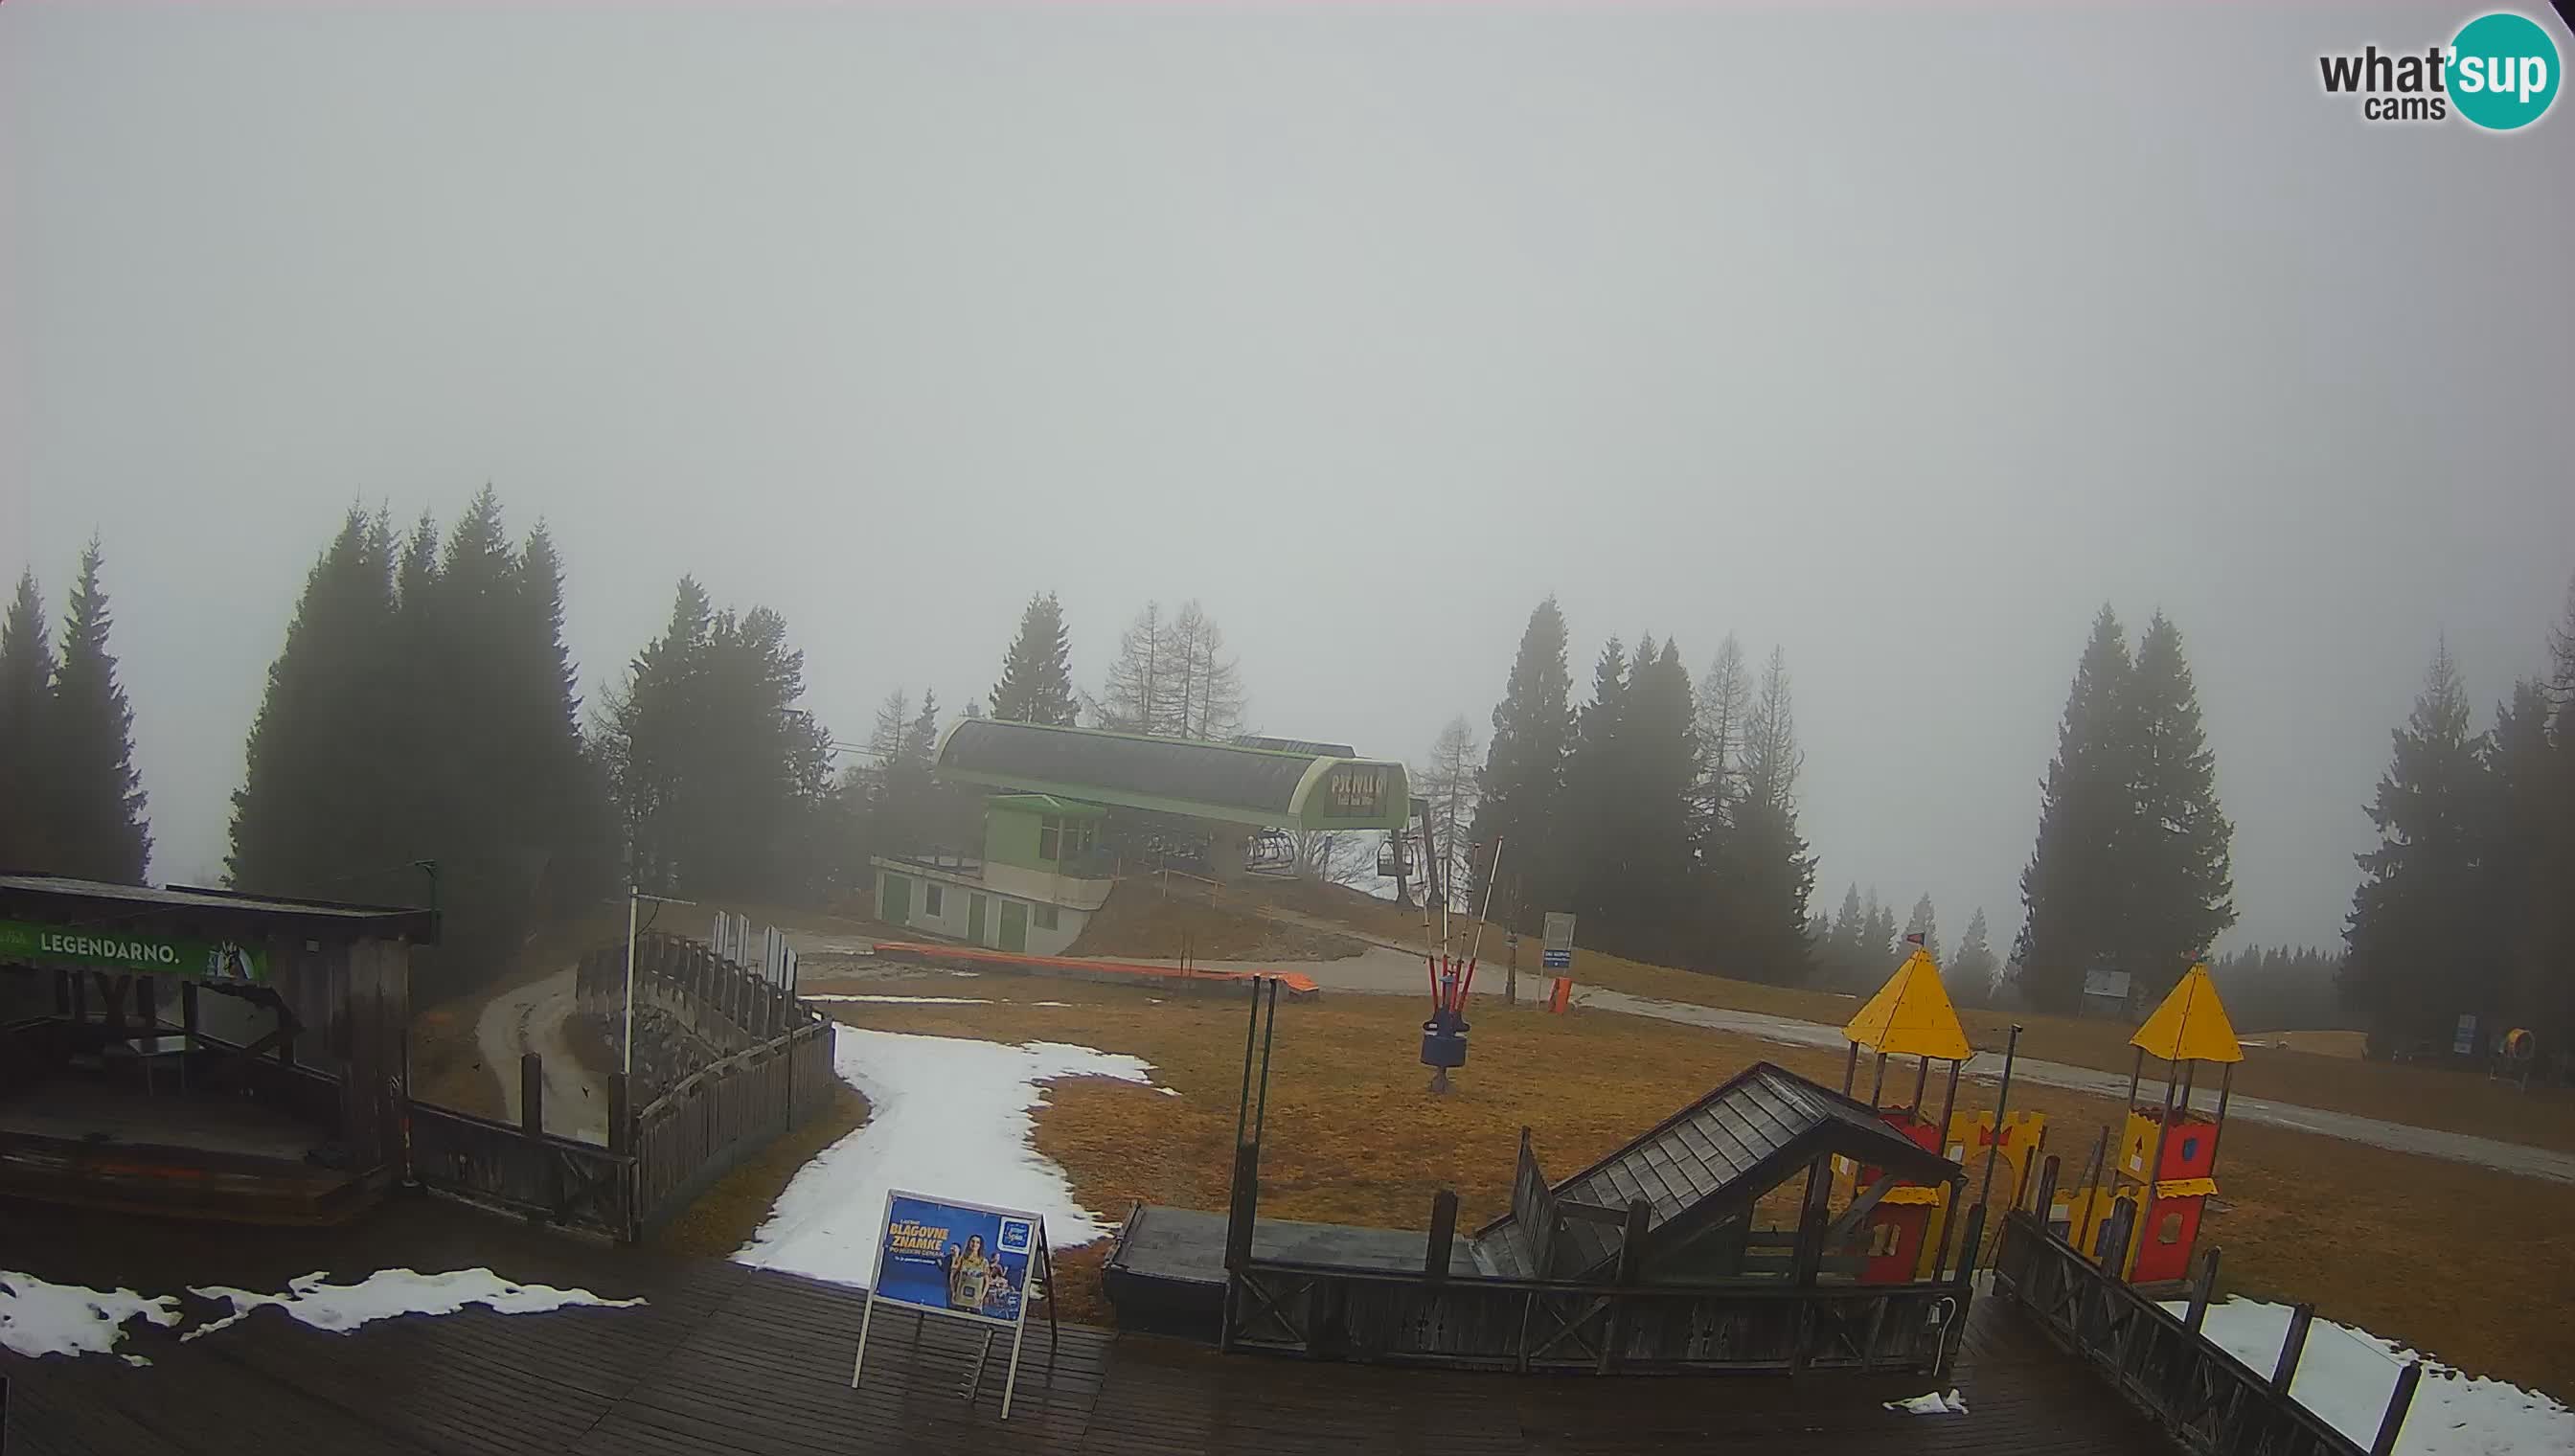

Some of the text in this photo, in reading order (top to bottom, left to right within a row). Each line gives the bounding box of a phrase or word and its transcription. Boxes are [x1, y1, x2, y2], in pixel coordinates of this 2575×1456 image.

[40, 932, 180, 964] LEGENDARNO.
[890, 1223, 949, 1240] BLAGOVNE
[891, 1235, 944, 1251] ZNAMKE
